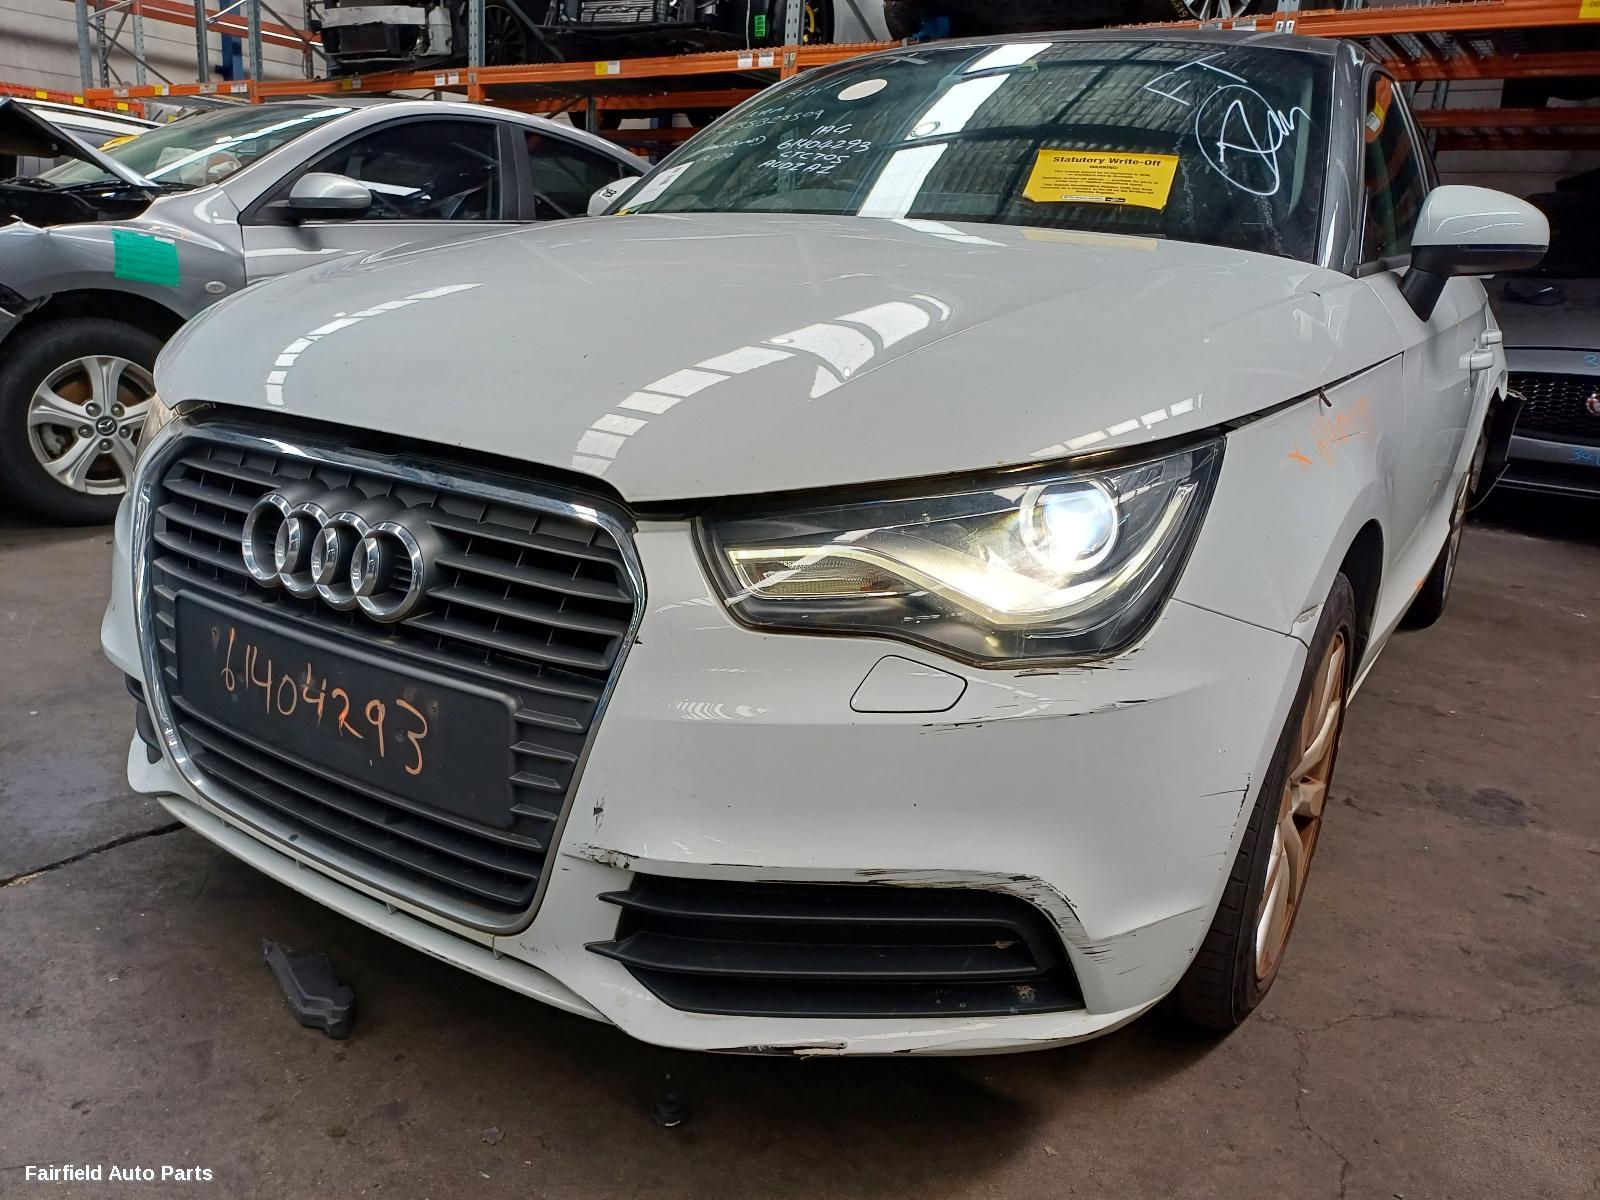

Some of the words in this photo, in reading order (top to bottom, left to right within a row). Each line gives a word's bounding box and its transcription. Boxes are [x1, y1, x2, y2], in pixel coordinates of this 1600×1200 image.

[776, 138, 872, 153] 61404293
[757, 159, 806, 171] AUDI
[1052, 156, 1105, 165] Statutory
[1108, 157, 1162, 167] Write-Off
[221, 626, 428, 775] 61404293
